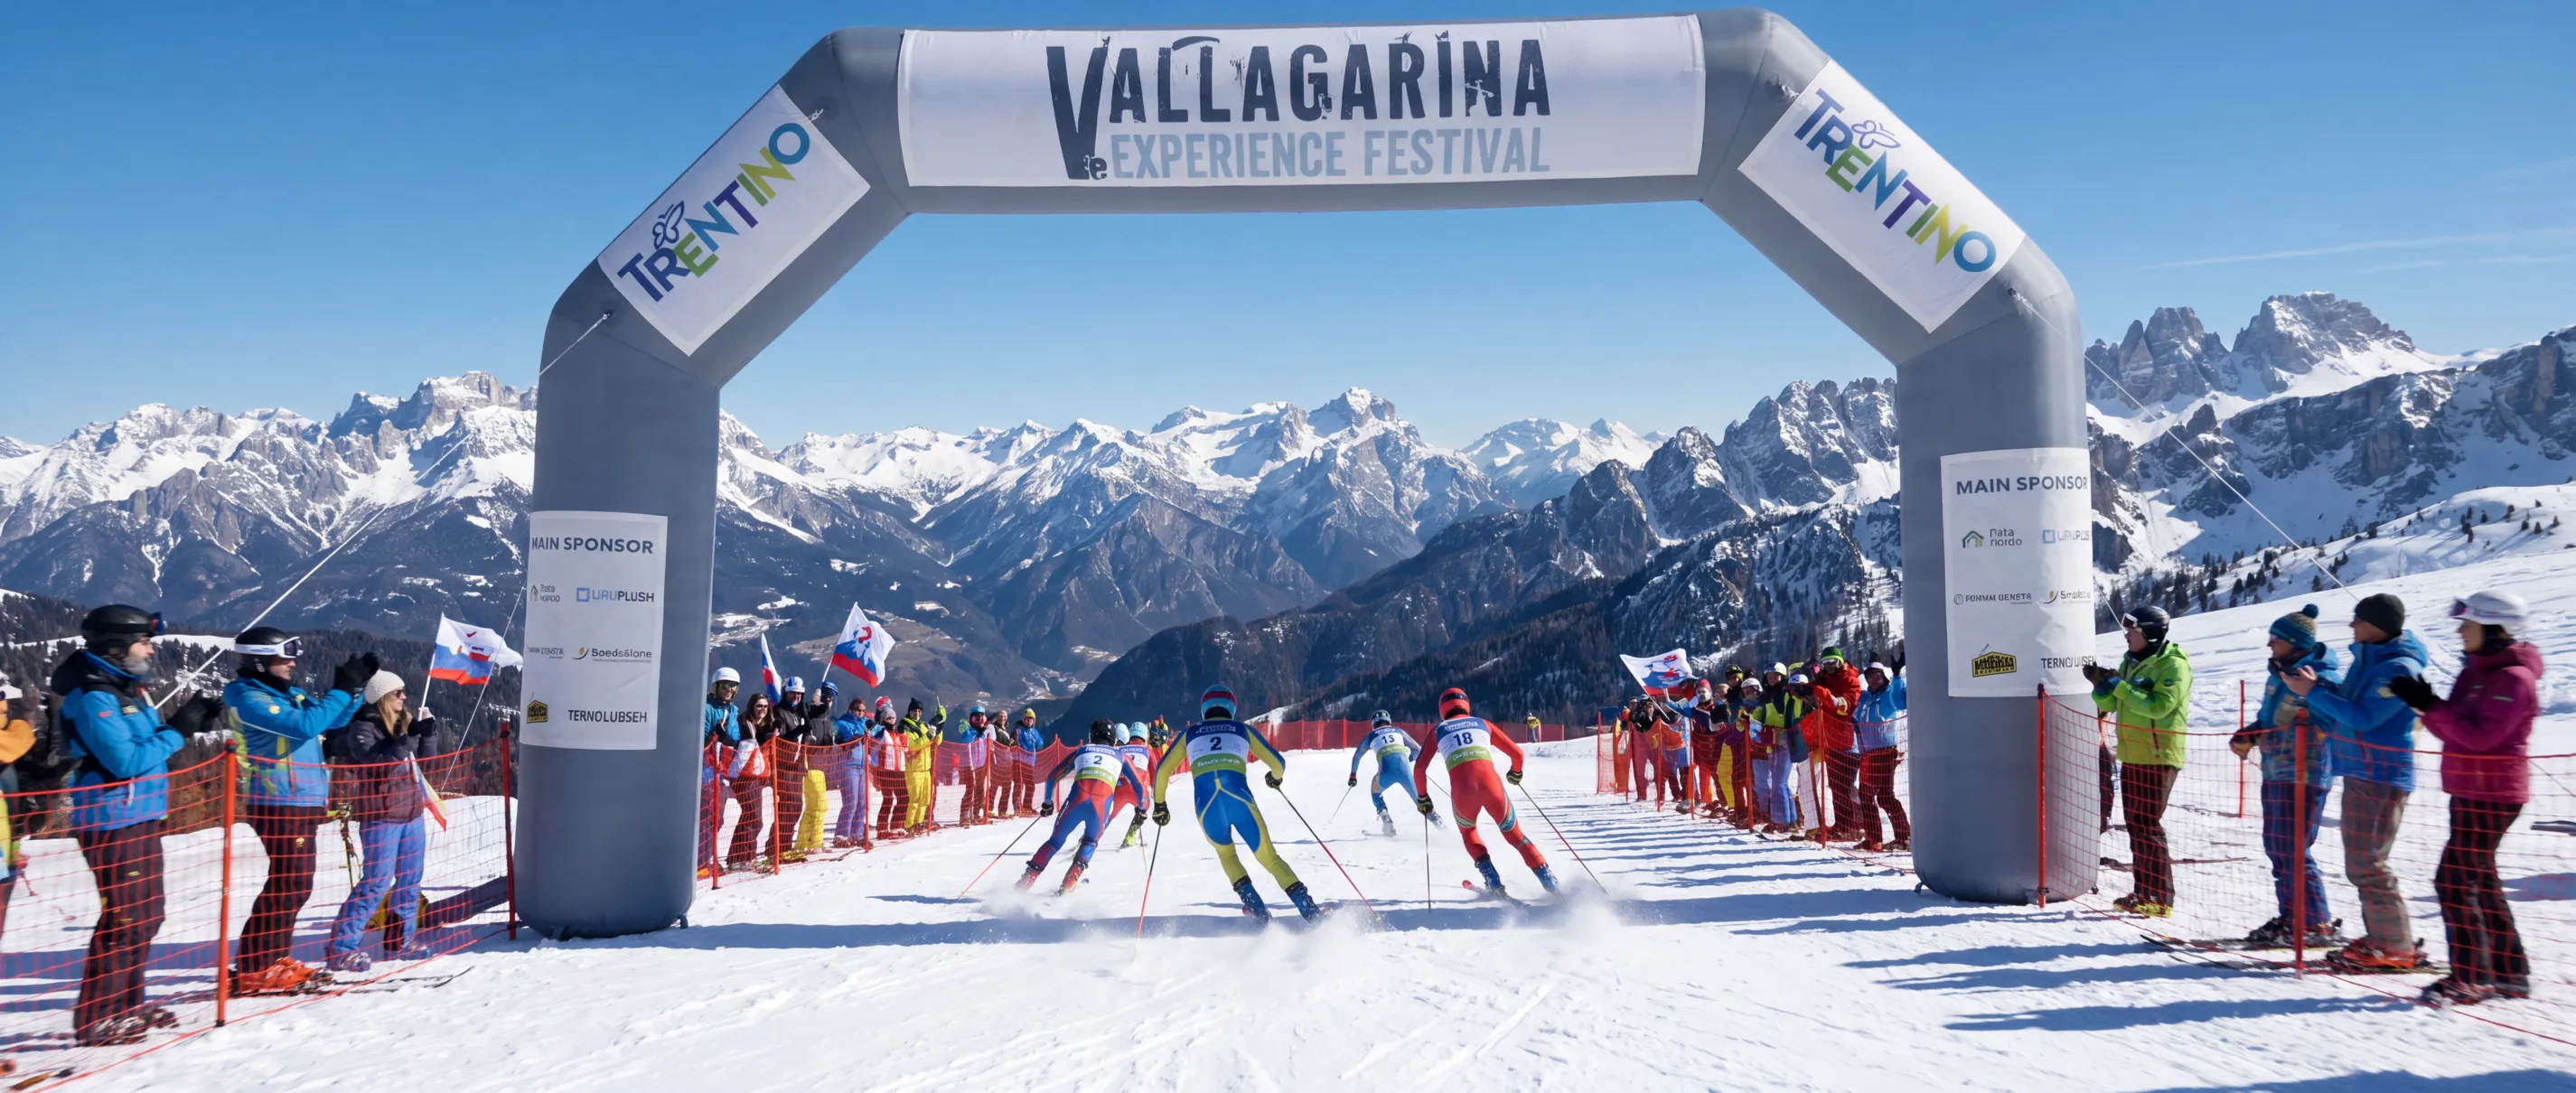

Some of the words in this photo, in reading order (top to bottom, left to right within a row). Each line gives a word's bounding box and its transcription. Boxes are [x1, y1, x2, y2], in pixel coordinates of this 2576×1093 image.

[1046, 39, 1551, 180] VALLAGARINA
[1110, 131, 1346, 179] EXPERIENCE
[1364, 126, 1550, 176] FESTIVAL
[1794, 88, 1997, 273] TRENTINO
[616, 122, 810, 303] TRENTINO
[1956, 478, 2010, 495] MAIN
[2016, 475, 2088, 491] SPONSOR
[563, 537, 653, 554] SPONSOR
[592, 589, 655, 603] URUPLUSH
[1210, 736, 1222, 751] 2
[1453, 732, 1473, 746] 18
[1093, 755, 1103, 765] 2
